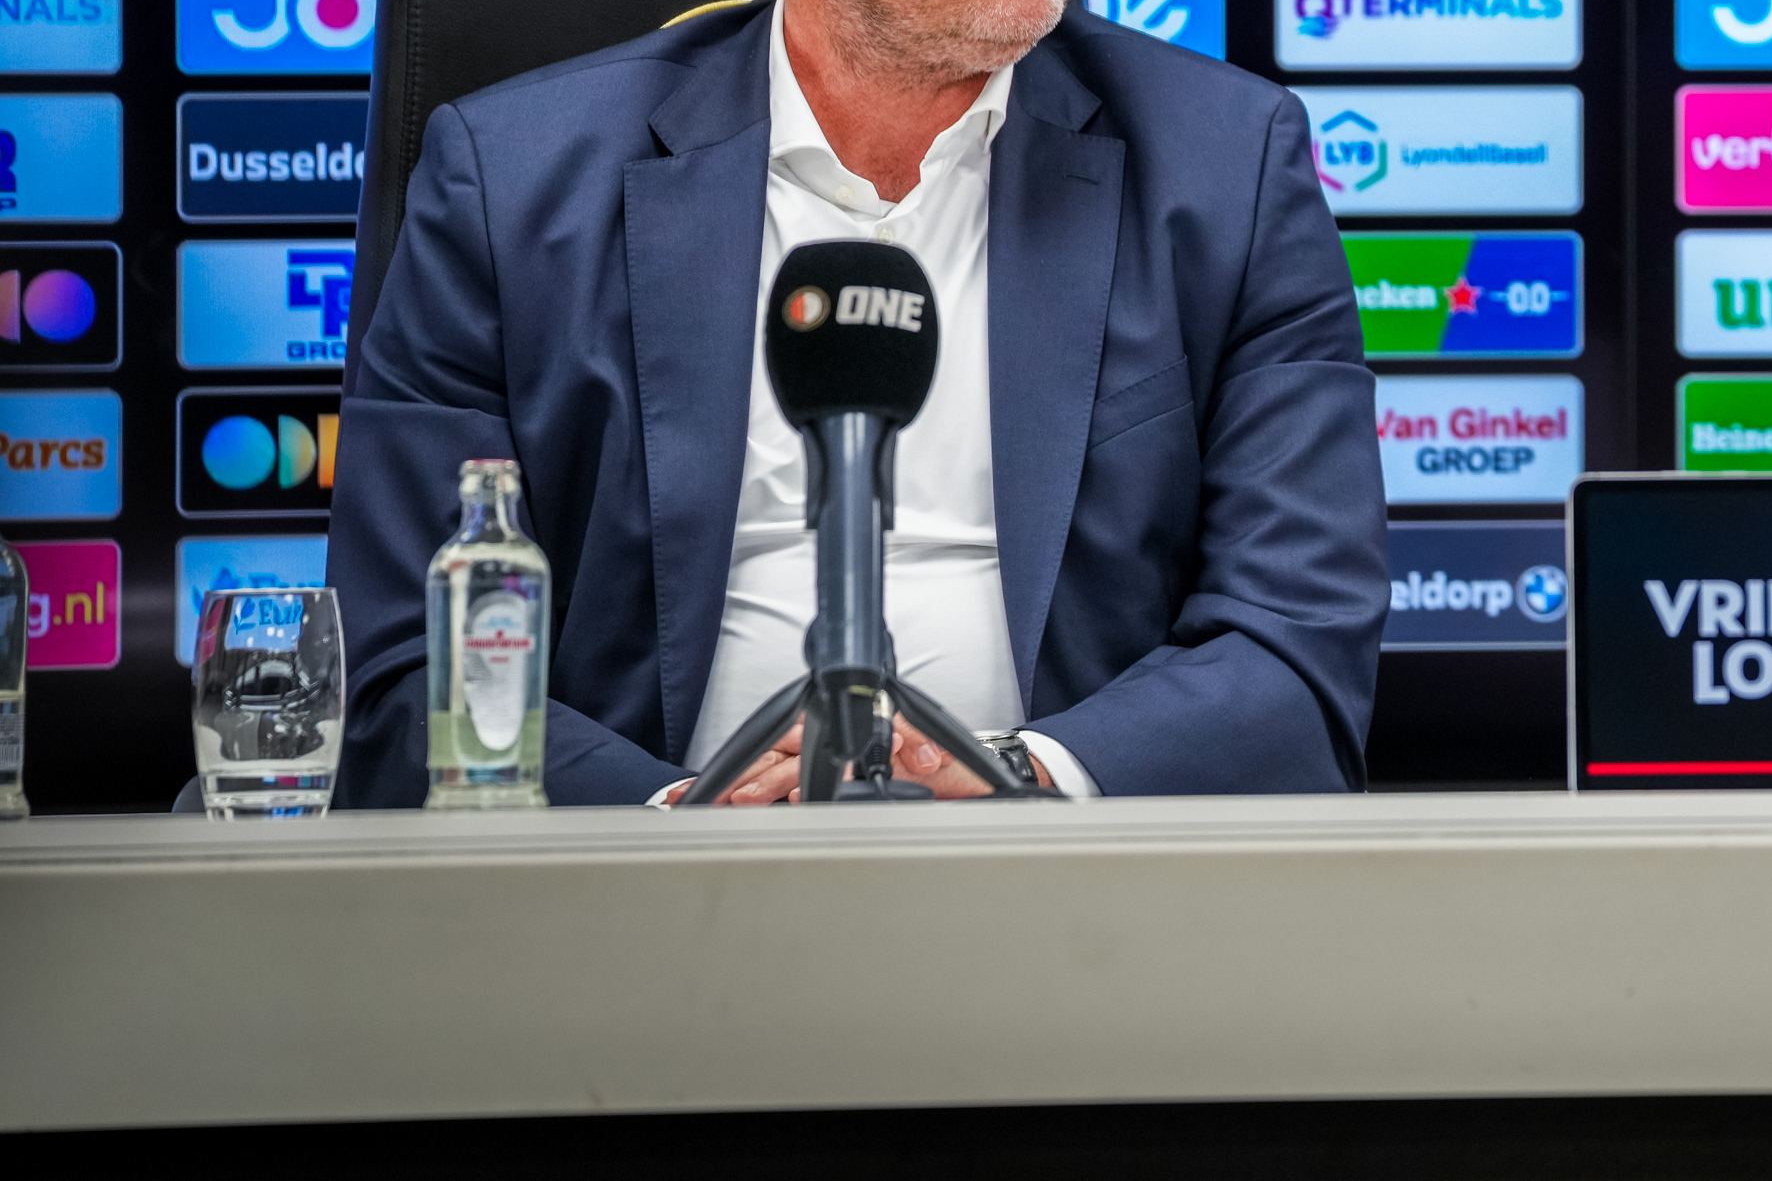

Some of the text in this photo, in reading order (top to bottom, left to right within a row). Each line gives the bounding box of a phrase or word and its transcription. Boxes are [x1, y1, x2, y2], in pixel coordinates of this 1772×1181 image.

[188, 141, 364, 183] Dusseld
[834, 285, 926, 334] ONE
[1449, 407, 1569, 440] Ginkel
[1415, 446, 1536, 475] GROEP
[1390, 571, 1514, 617] eldorp
